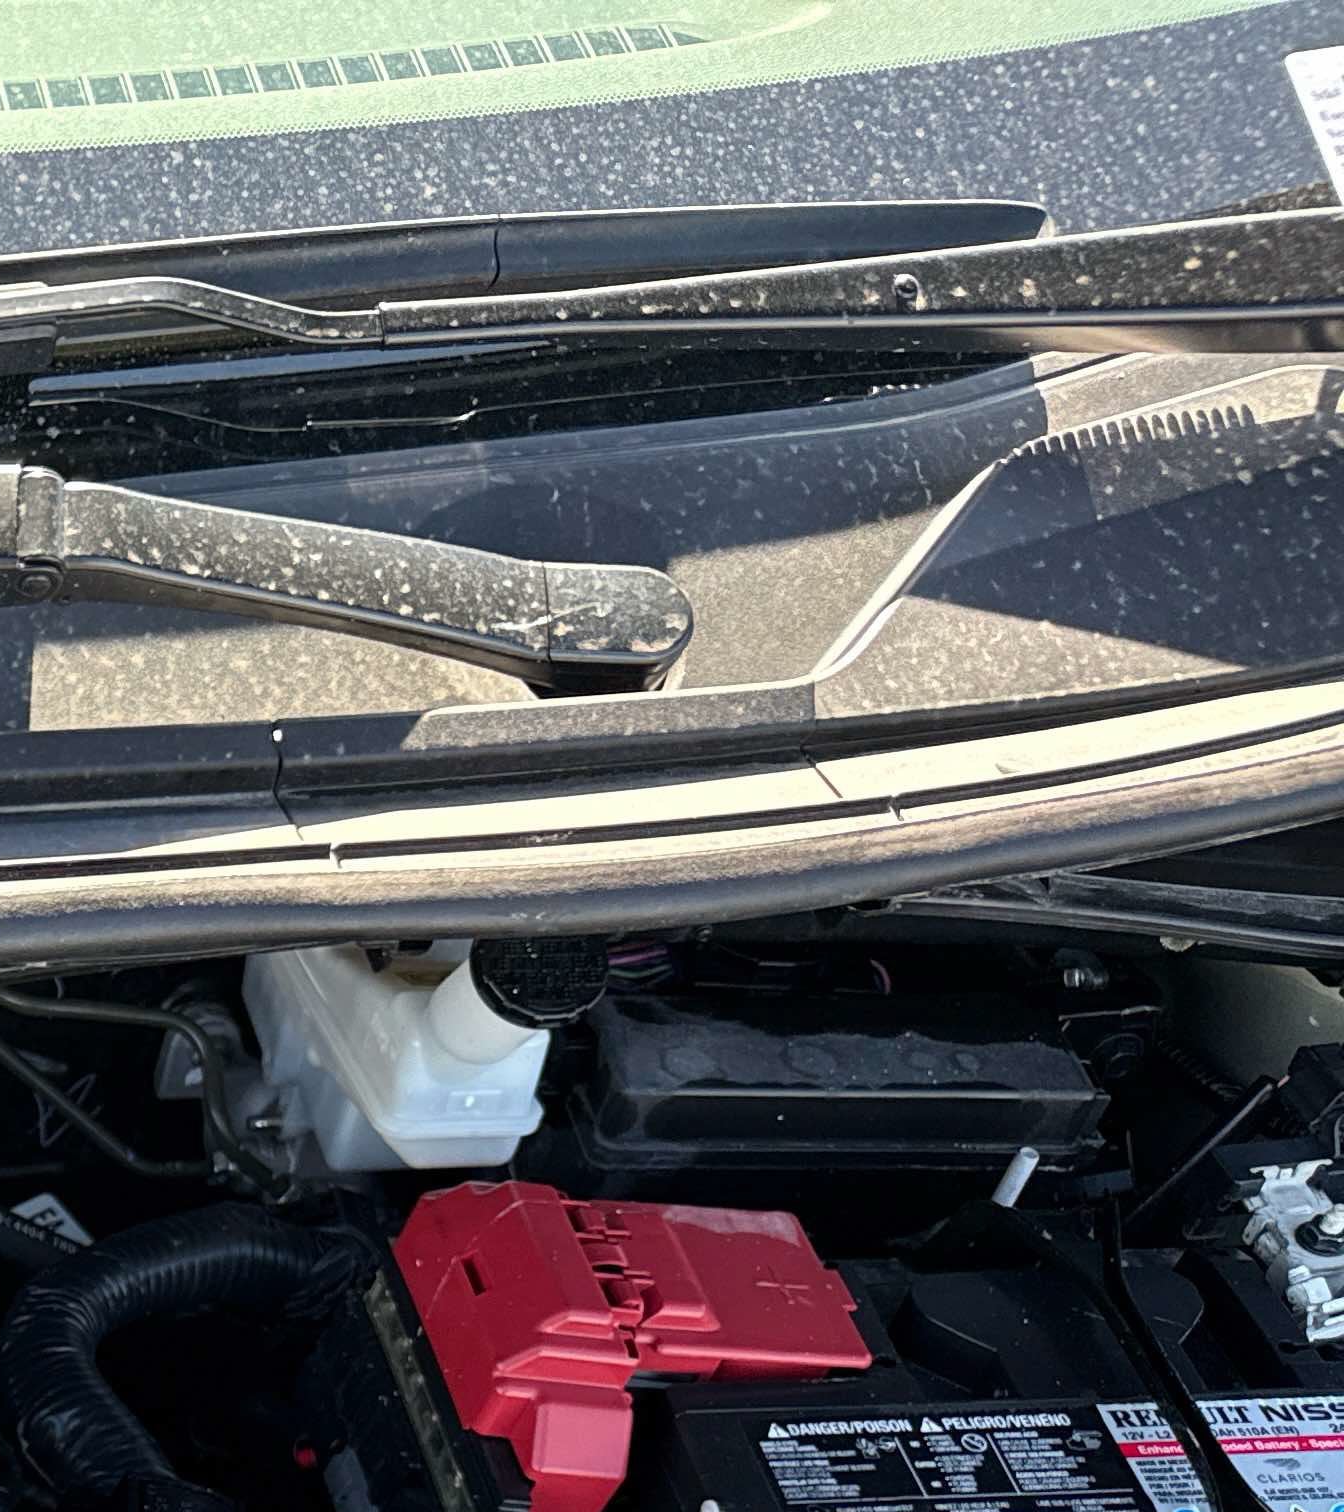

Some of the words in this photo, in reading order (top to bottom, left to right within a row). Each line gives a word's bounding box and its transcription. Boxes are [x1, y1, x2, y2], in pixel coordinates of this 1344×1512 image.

[786, 1419, 913, 1437] DANGER/POISON
[941, 1413, 1072, 1431] PELIGRO/VENENO
[1256, 1440, 1300, 1451] Battery
[1257, 1472, 1326, 1483] CLARIOS
